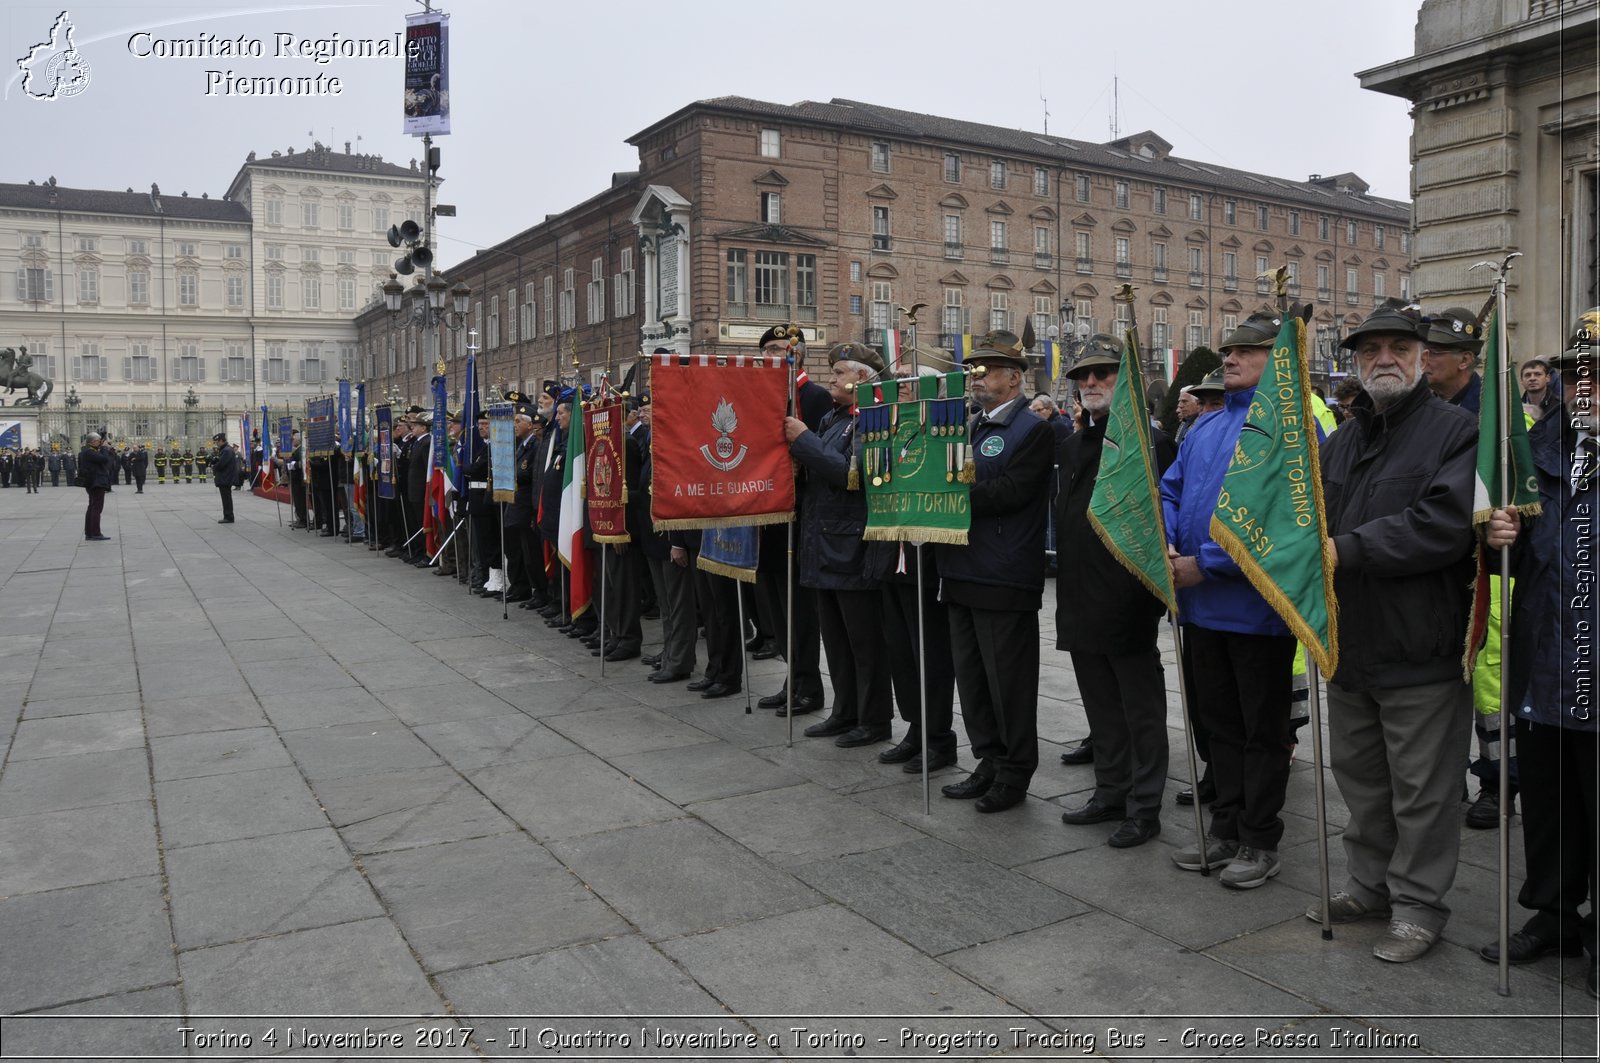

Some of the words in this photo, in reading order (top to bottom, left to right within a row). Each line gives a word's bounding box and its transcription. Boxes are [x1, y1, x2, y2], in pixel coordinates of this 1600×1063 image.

[1273, 346, 1298, 427] SEZIONE
[1283, 430, 1299, 449] DI
[674, 484, 683, 497] A
[687, 483, 705, 496] ME
[710, 482, 724, 495] LE
[727, 479, 775, 494] GUARDIE
[1284, 455, 1312, 528] TORINO
[915, 492, 967, 514] TORINO
